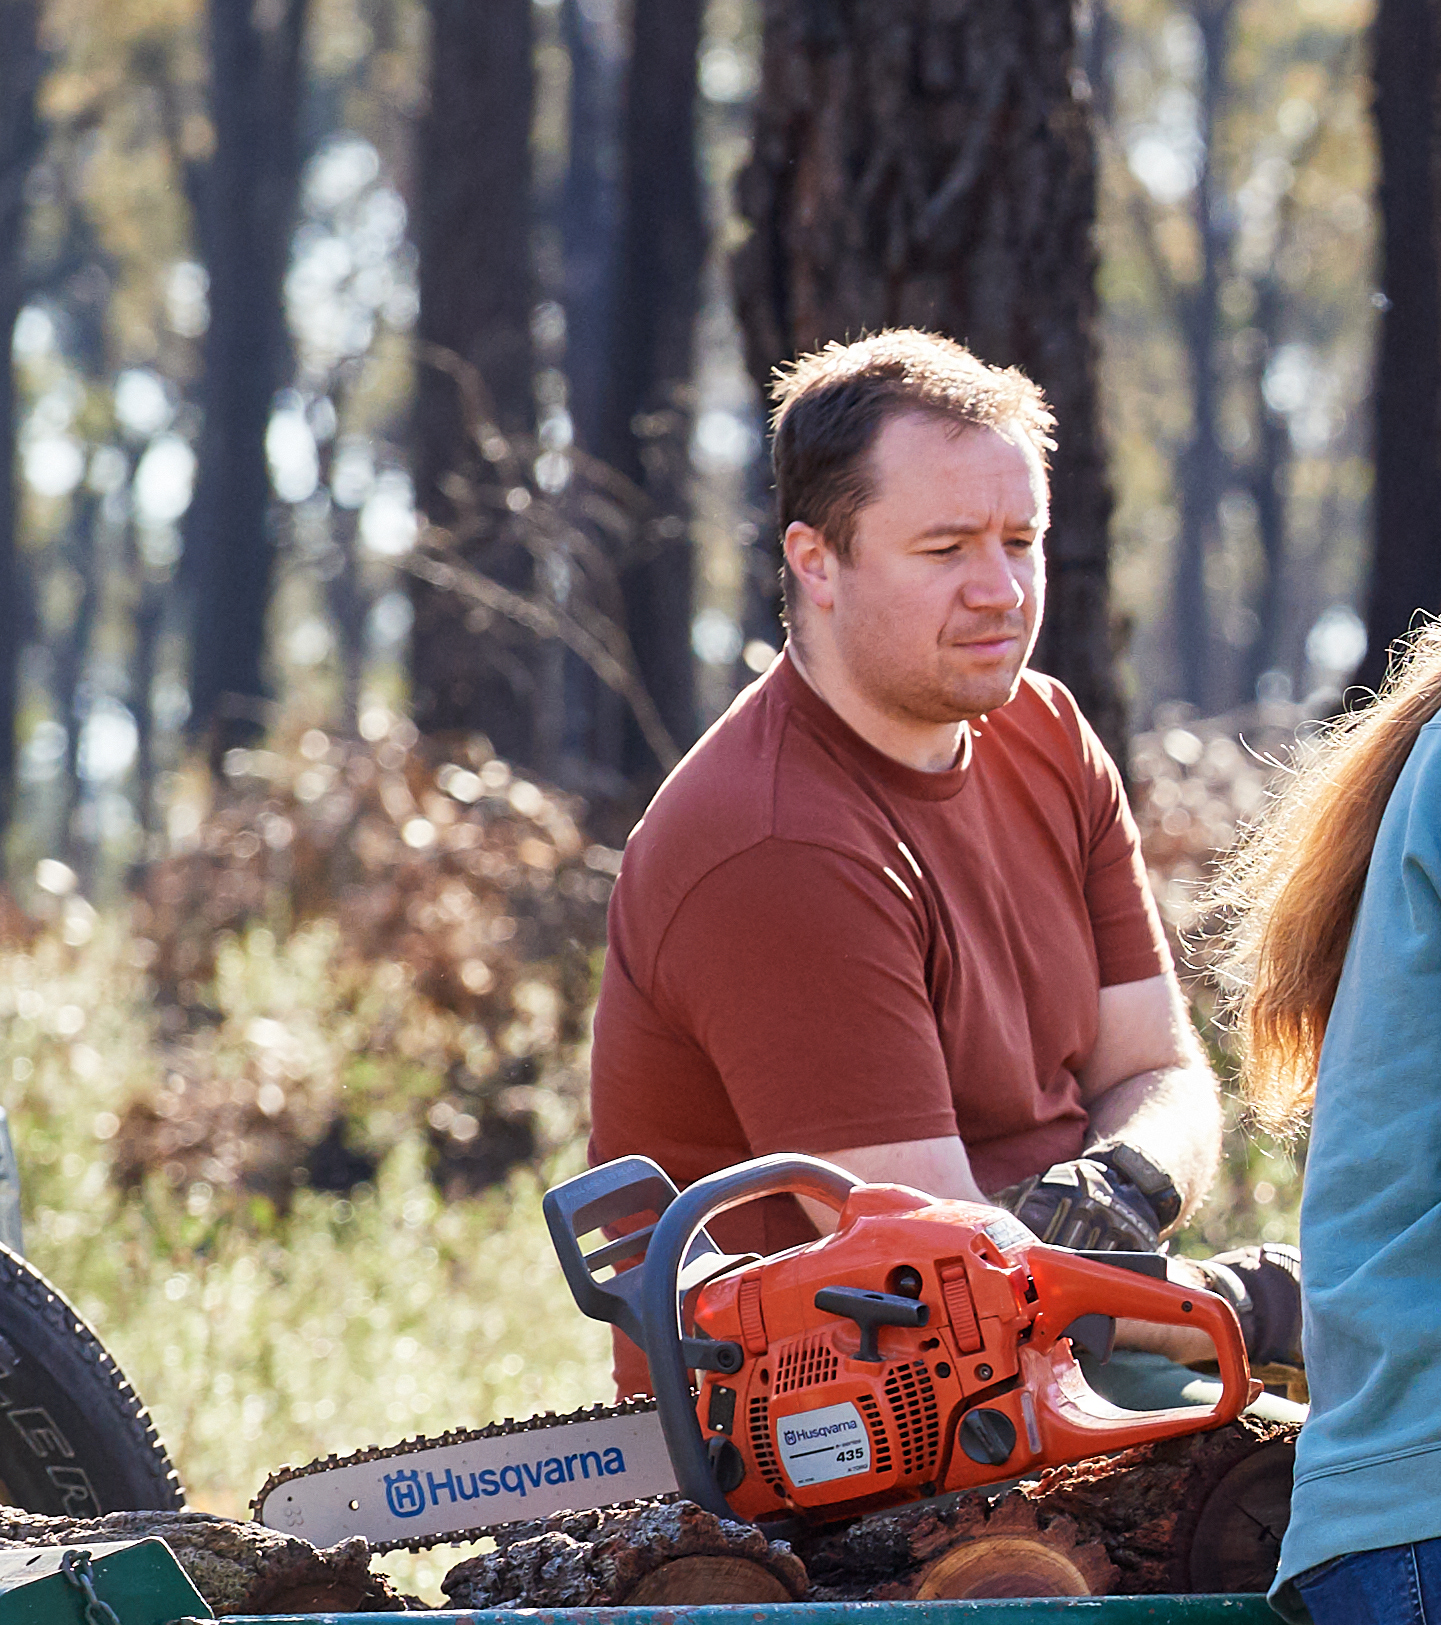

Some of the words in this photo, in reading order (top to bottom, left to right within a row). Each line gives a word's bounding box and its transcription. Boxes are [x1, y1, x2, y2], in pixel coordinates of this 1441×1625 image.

[796, 1420, 858, 1441] Husqvarna
[836, 1447, 864, 1462] 435
[426, 1446, 627, 1506] Husqvarna
